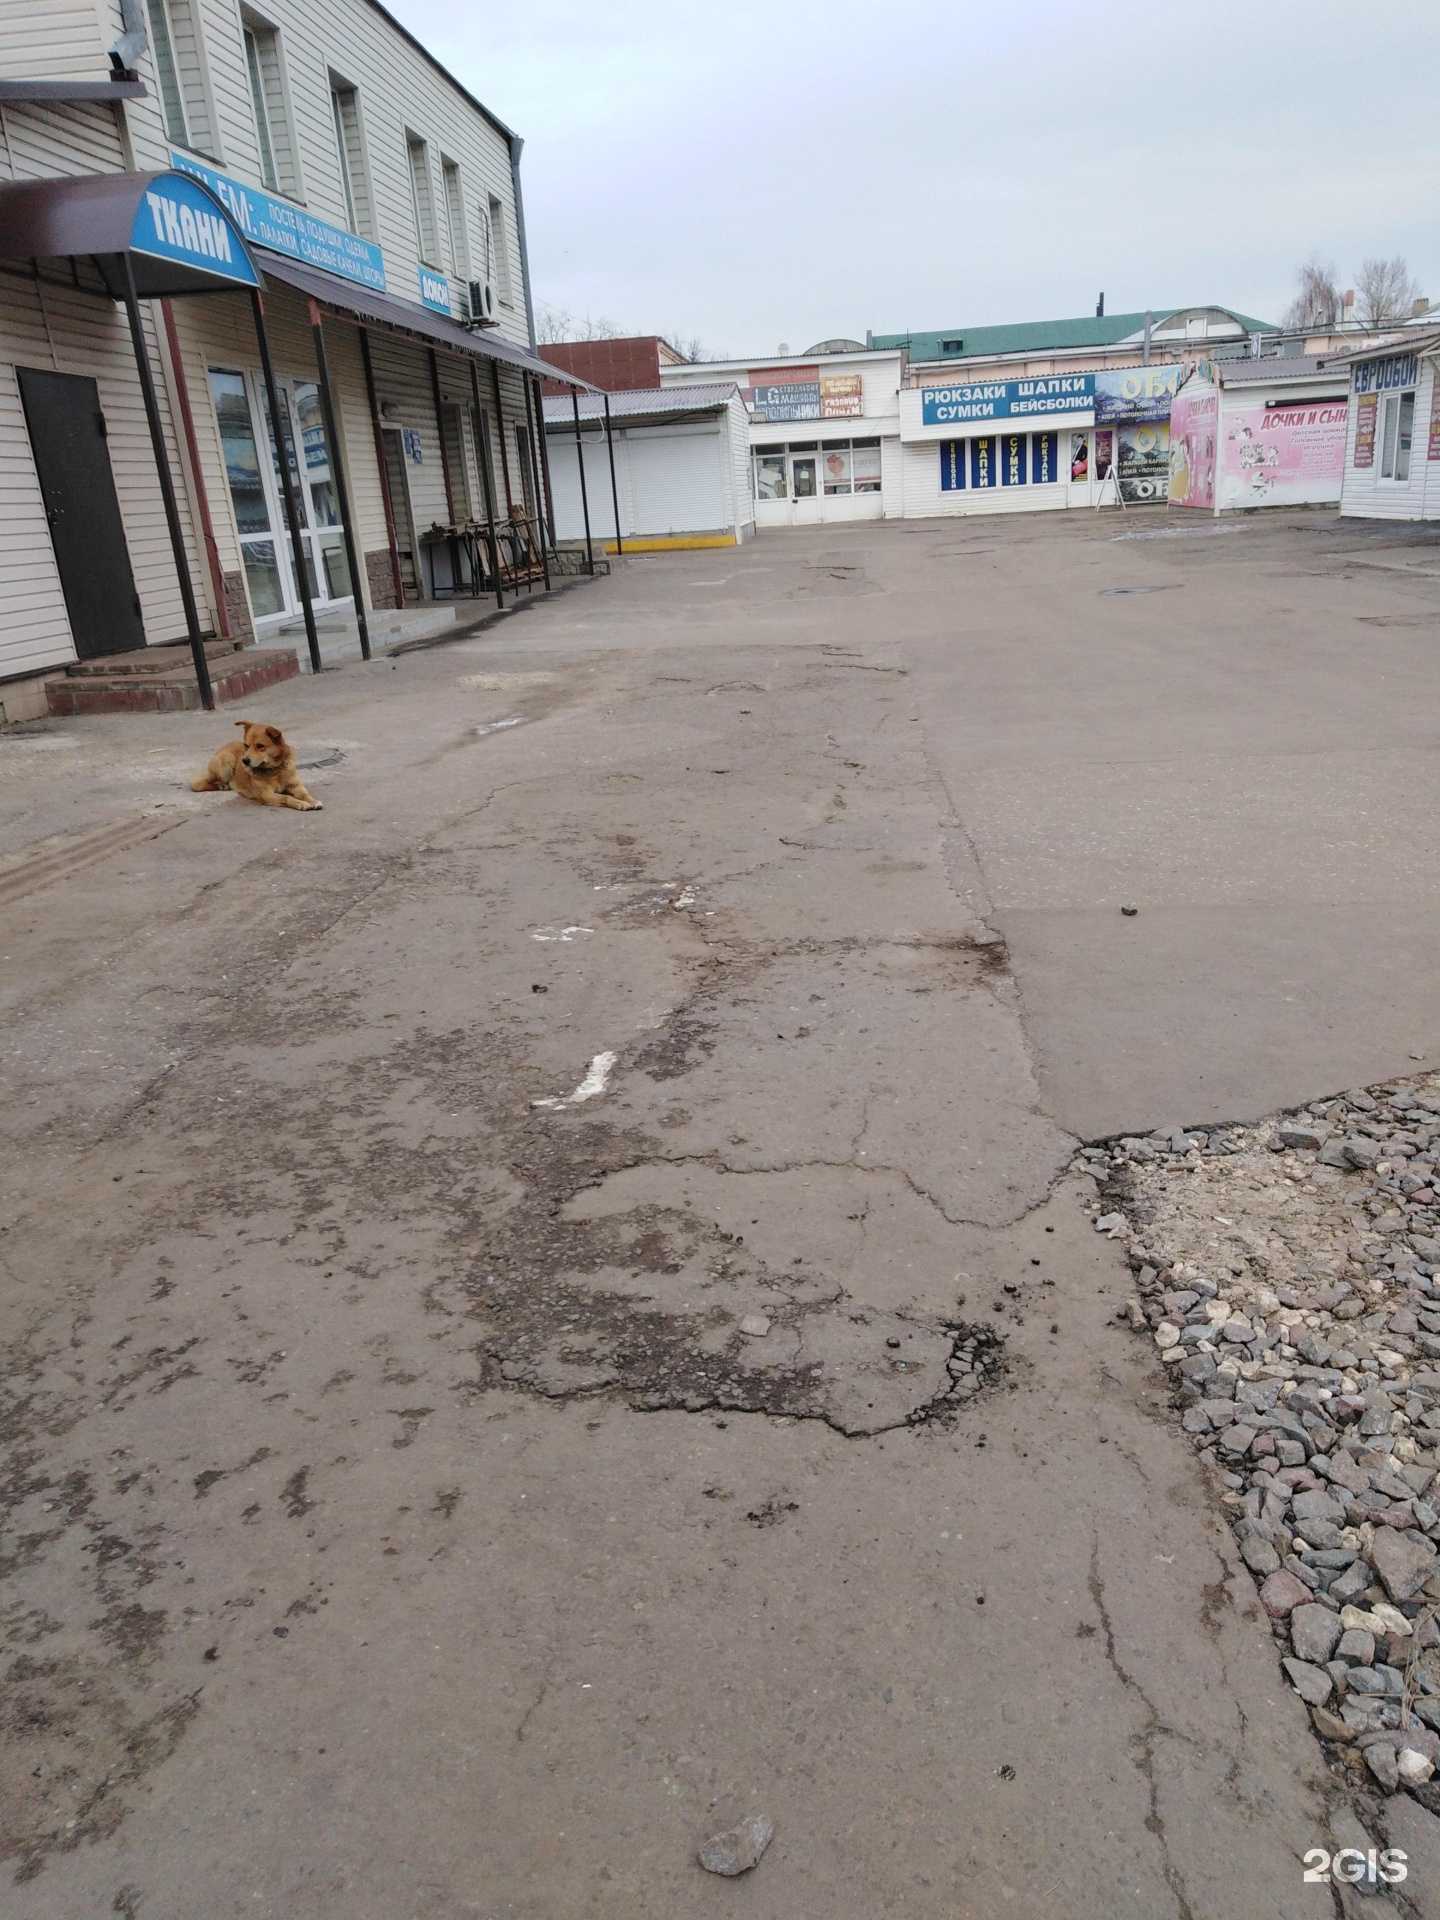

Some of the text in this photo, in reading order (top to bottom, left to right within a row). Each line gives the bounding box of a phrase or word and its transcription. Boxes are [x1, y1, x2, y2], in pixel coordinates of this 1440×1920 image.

[145, 190, 232, 263] ТКАНИ
[924, 377, 1085, 404] РЮКЗАКИ ШАПКИ
[936, 403, 994, 420] СУМКИ
[1010, 395, 1093, 414] БЕЙСБОЛКИ
[1261, 412, 1305, 430] ДОЧКИ
[1308, 410, 1317, 425] И
[979, 440, 989, 487] ШАПКИ
[1009, 437, 1019, 484] СУМКИ
[1041, 434, 1049, 483] РЮКЗАКИ
